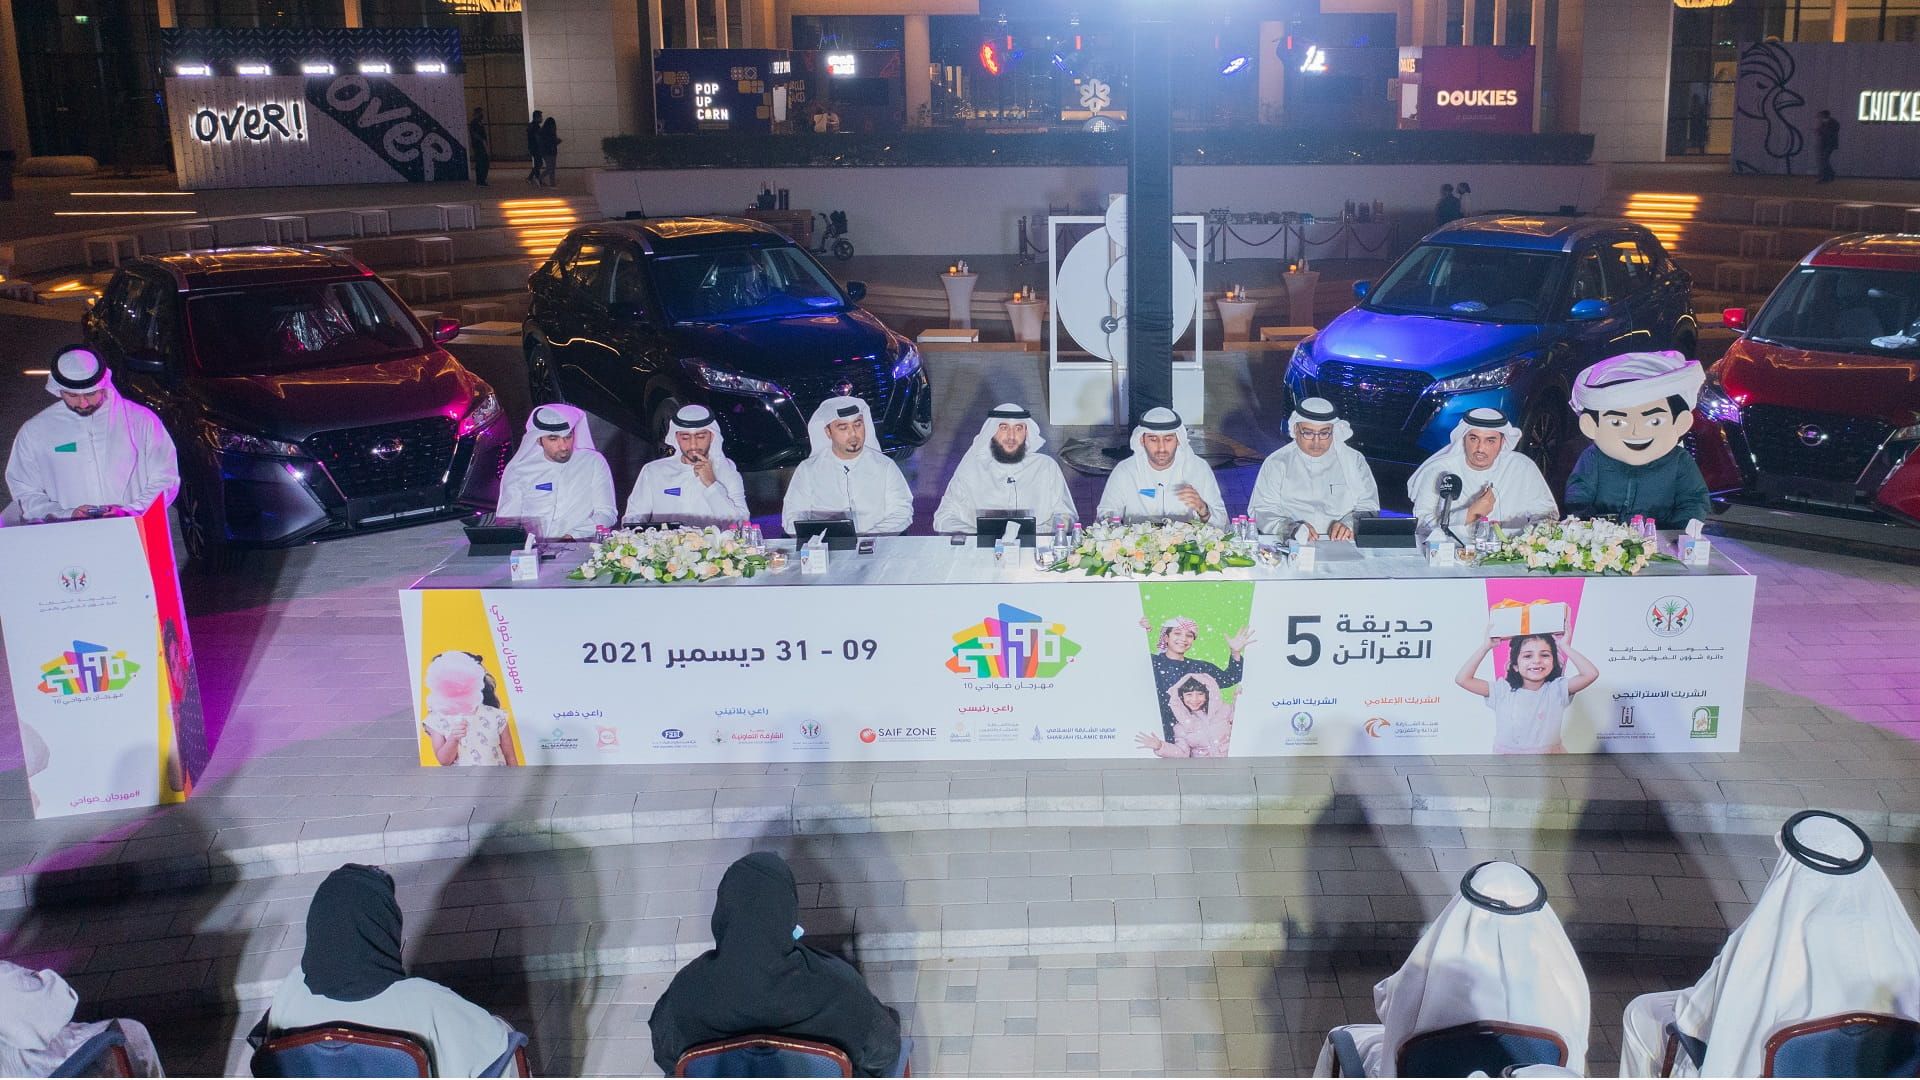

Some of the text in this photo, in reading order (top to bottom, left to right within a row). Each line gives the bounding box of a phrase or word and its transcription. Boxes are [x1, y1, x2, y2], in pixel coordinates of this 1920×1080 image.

[695, 83, 719, 95] POP
[695, 96, 712, 107] UP
[1437, 90, 1518, 106] DOUKIES
[697, 108, 729, 120] CORN
[1336, 614, 1433, 638] حديقة
[1286, 615, 1321, 667] 5
[582, 642, 652, 664] 2021
[775, 640, 807, 661] 31
[843, 639, 878, 661] 09
[1332, 639, 1432, 665] القرائن
[666, 646, 765, 668] ديسمبر
[975, 682, 1012, 692] ضواحي
[1015, 682, 1054, 690] مهرجان
[1404, 696, 1440, 706] الشريك
[1612, 689, 1707, 702] الشريك الاستراتيجي
[1302, 697, 1337, 707] الشريك
[553, 709, 603, 720] راعي ذهبي
[715, 706, 769, 718] راعي بلاتيني
[958, 705, 1013, 715] راعي رئيسي
[878, 728, 937, 737] SAIF ZONE
